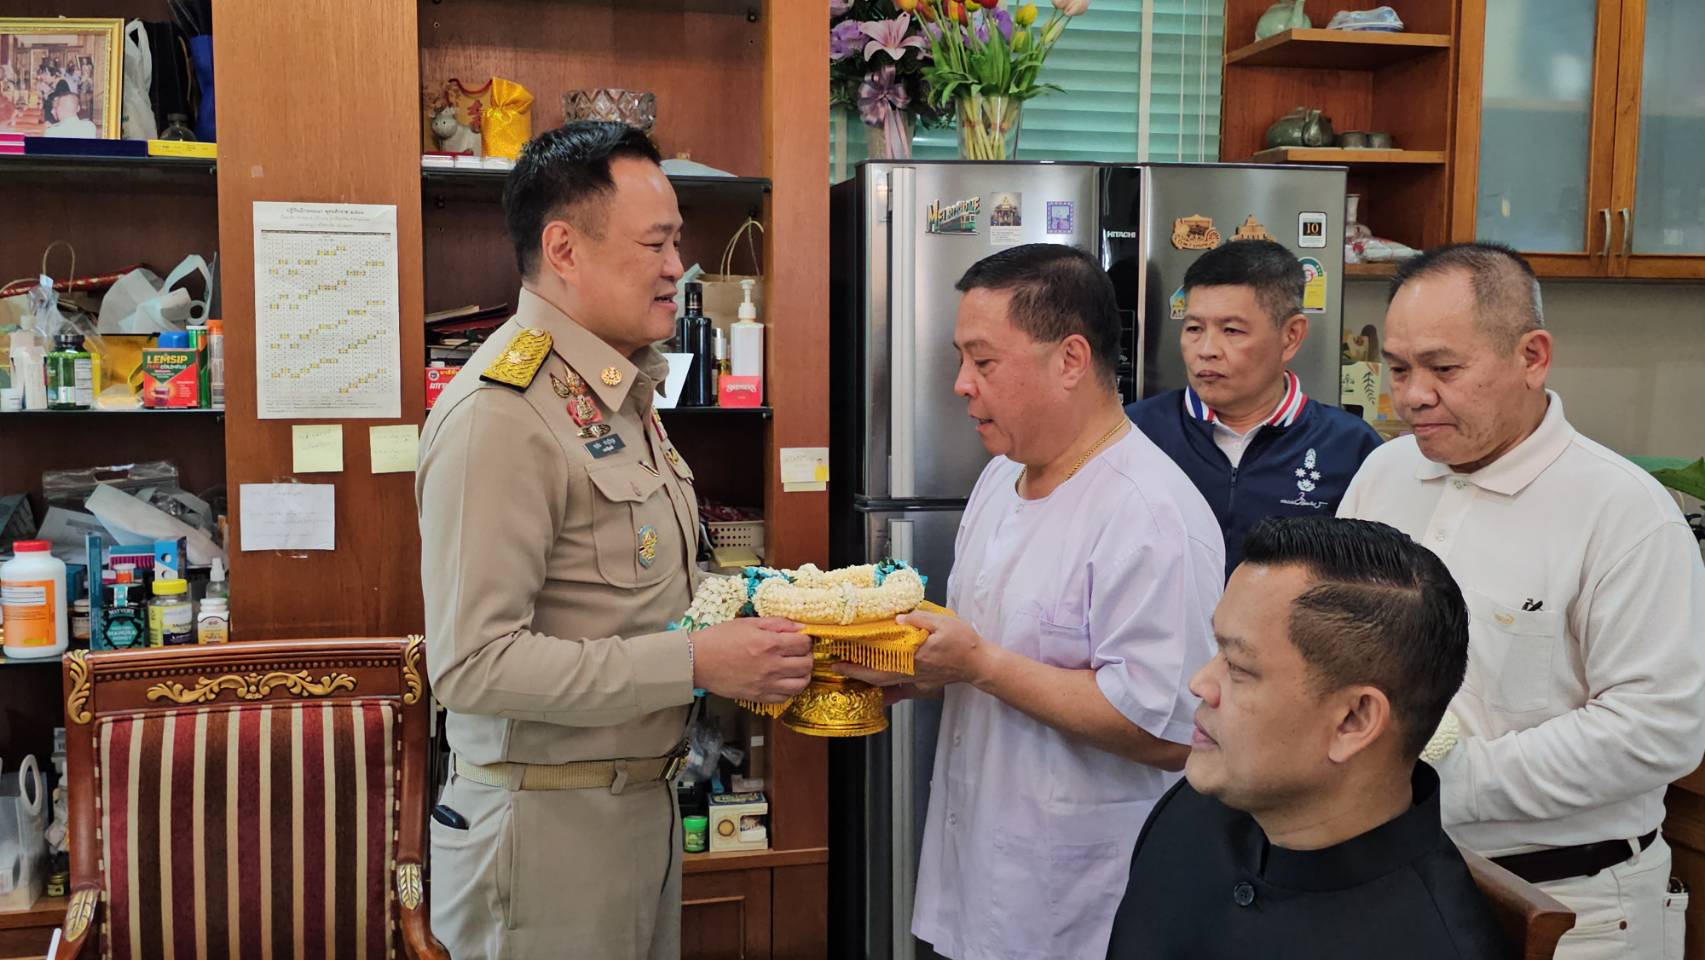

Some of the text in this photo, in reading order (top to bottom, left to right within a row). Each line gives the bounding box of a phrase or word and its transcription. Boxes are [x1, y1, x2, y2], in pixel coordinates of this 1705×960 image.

[1307, 223, 1319, 234] 10
[1106, 230, 1136, 238] HITACHI
[147, 354, 188, 364] LEMSIP
